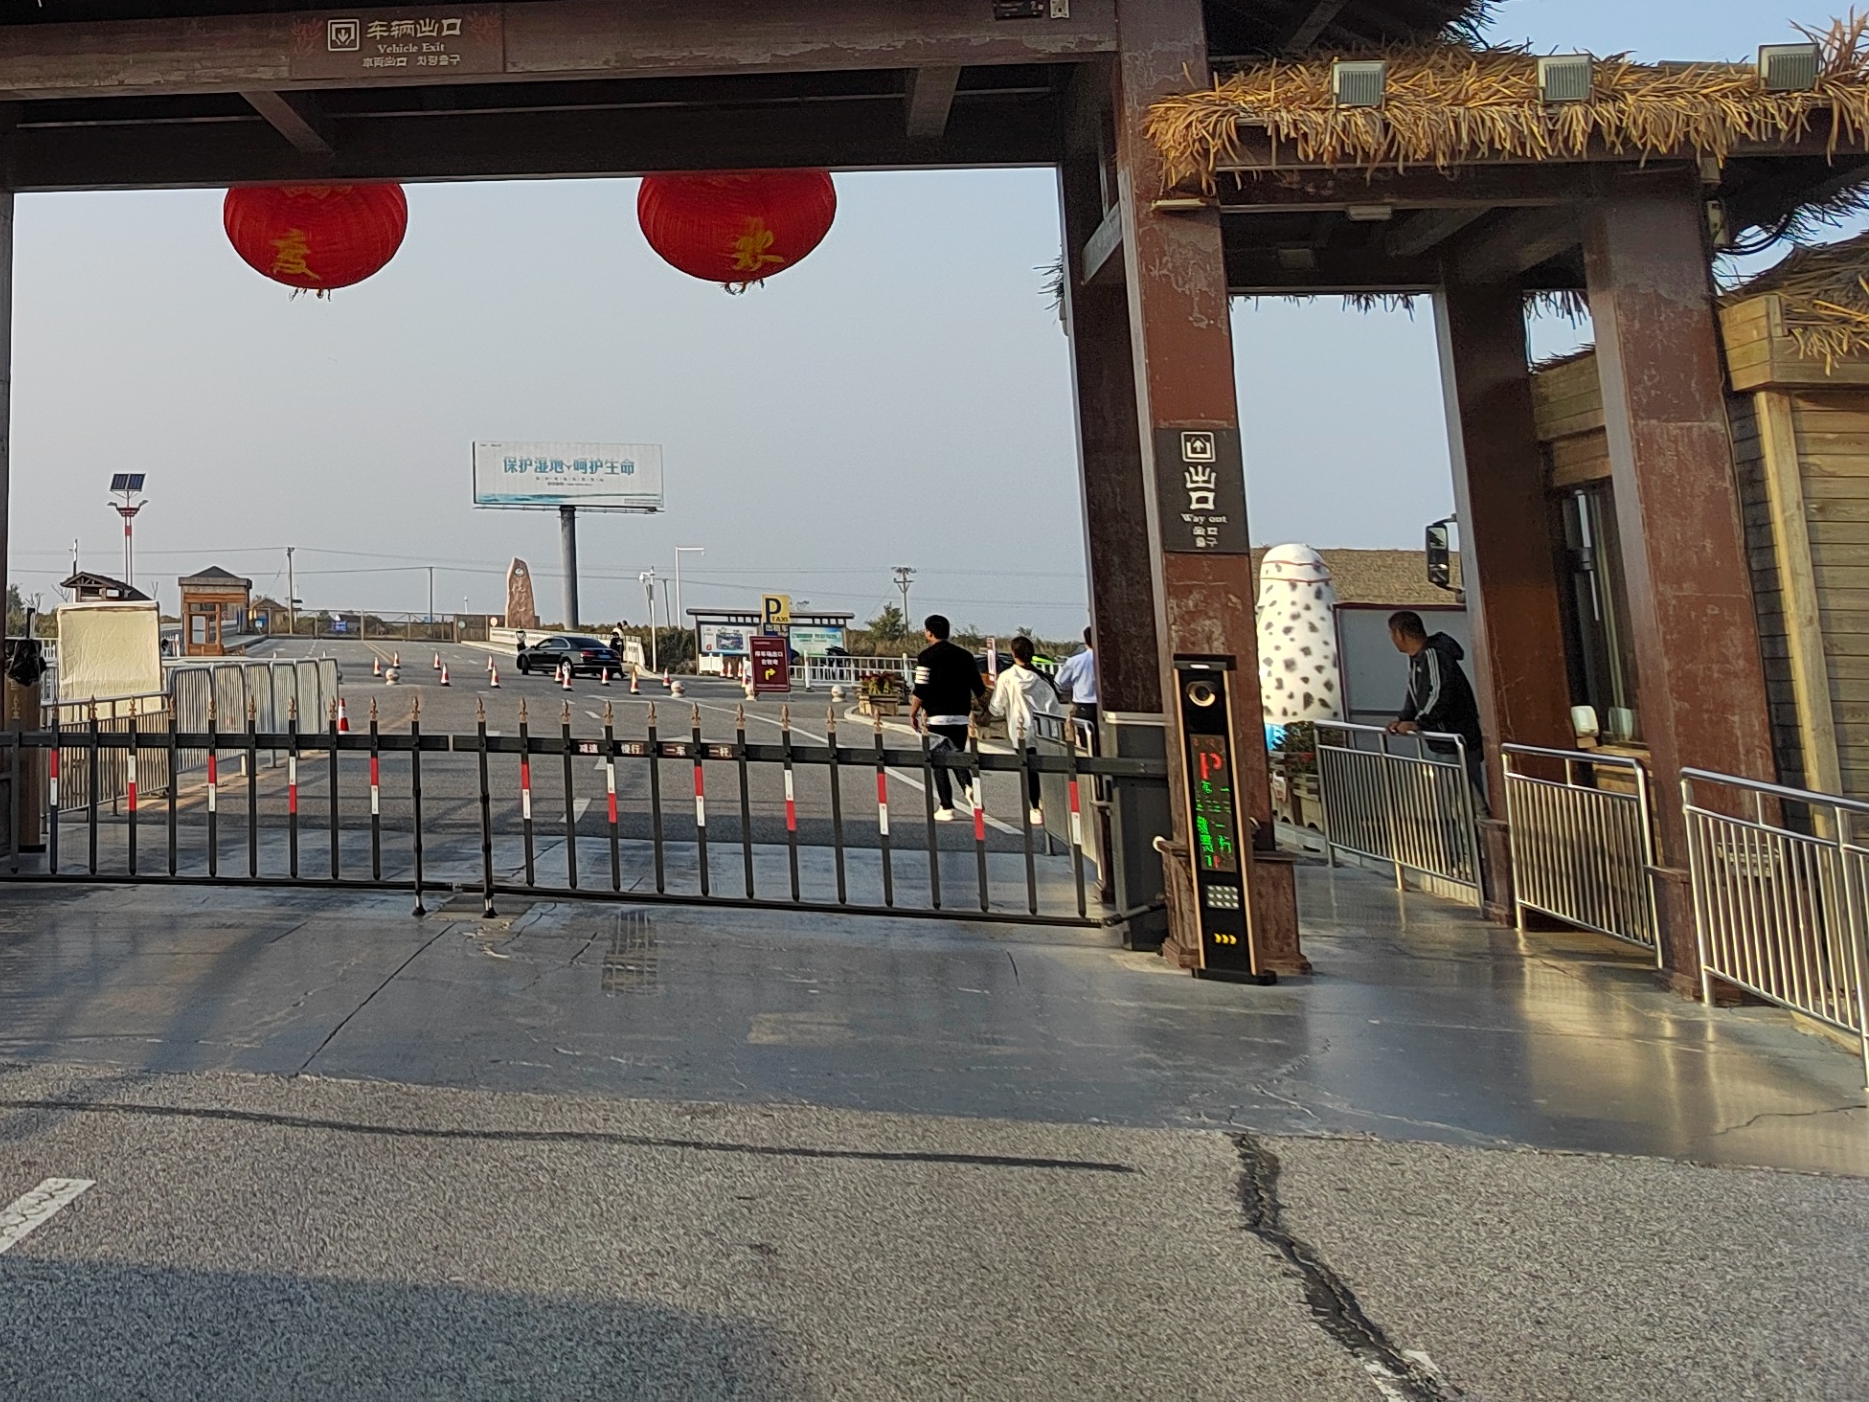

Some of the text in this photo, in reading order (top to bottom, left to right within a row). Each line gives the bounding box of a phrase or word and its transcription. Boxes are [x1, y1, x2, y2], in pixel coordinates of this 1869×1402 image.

[366, 17, 462, 40] 车辆出口
[376, 41, 446, 54] Vehicle Exit
[1184, 465, 1217, 510] 出口
[1180, 512, 1229, 525] Way out
[765, 597, 782, 624] P
